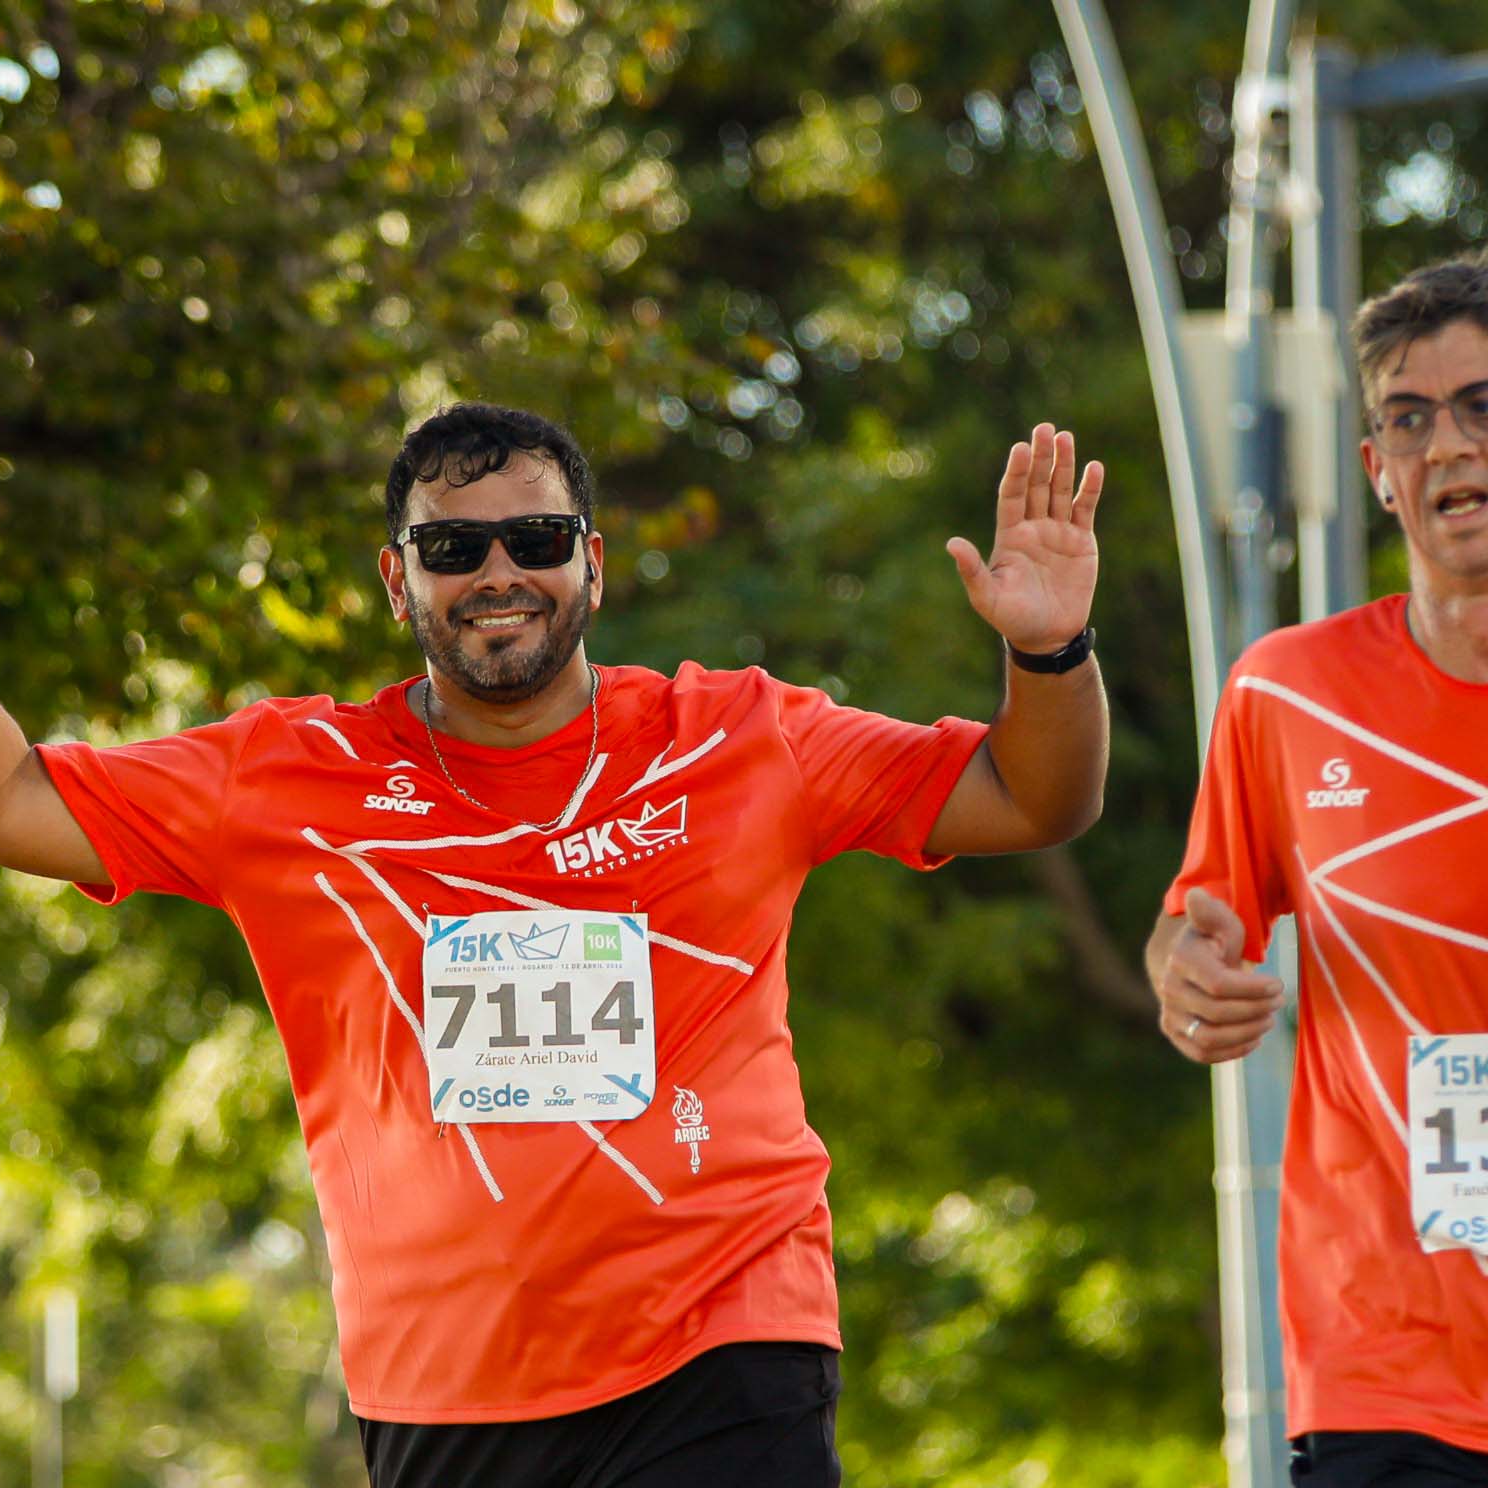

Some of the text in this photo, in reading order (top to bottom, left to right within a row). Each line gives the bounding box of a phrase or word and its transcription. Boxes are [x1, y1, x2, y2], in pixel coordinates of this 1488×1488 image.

[545, 821, 624, 874] 15K
[448, 932, 618, 963] 15K 10K
[431, 981, 644, 1049] 7114
[475, 1049, 598, 1066] Zárate Ariel David
[458, 1083, 530, 1112] osde
[674, 1125, 711, 1144] ARDEC
